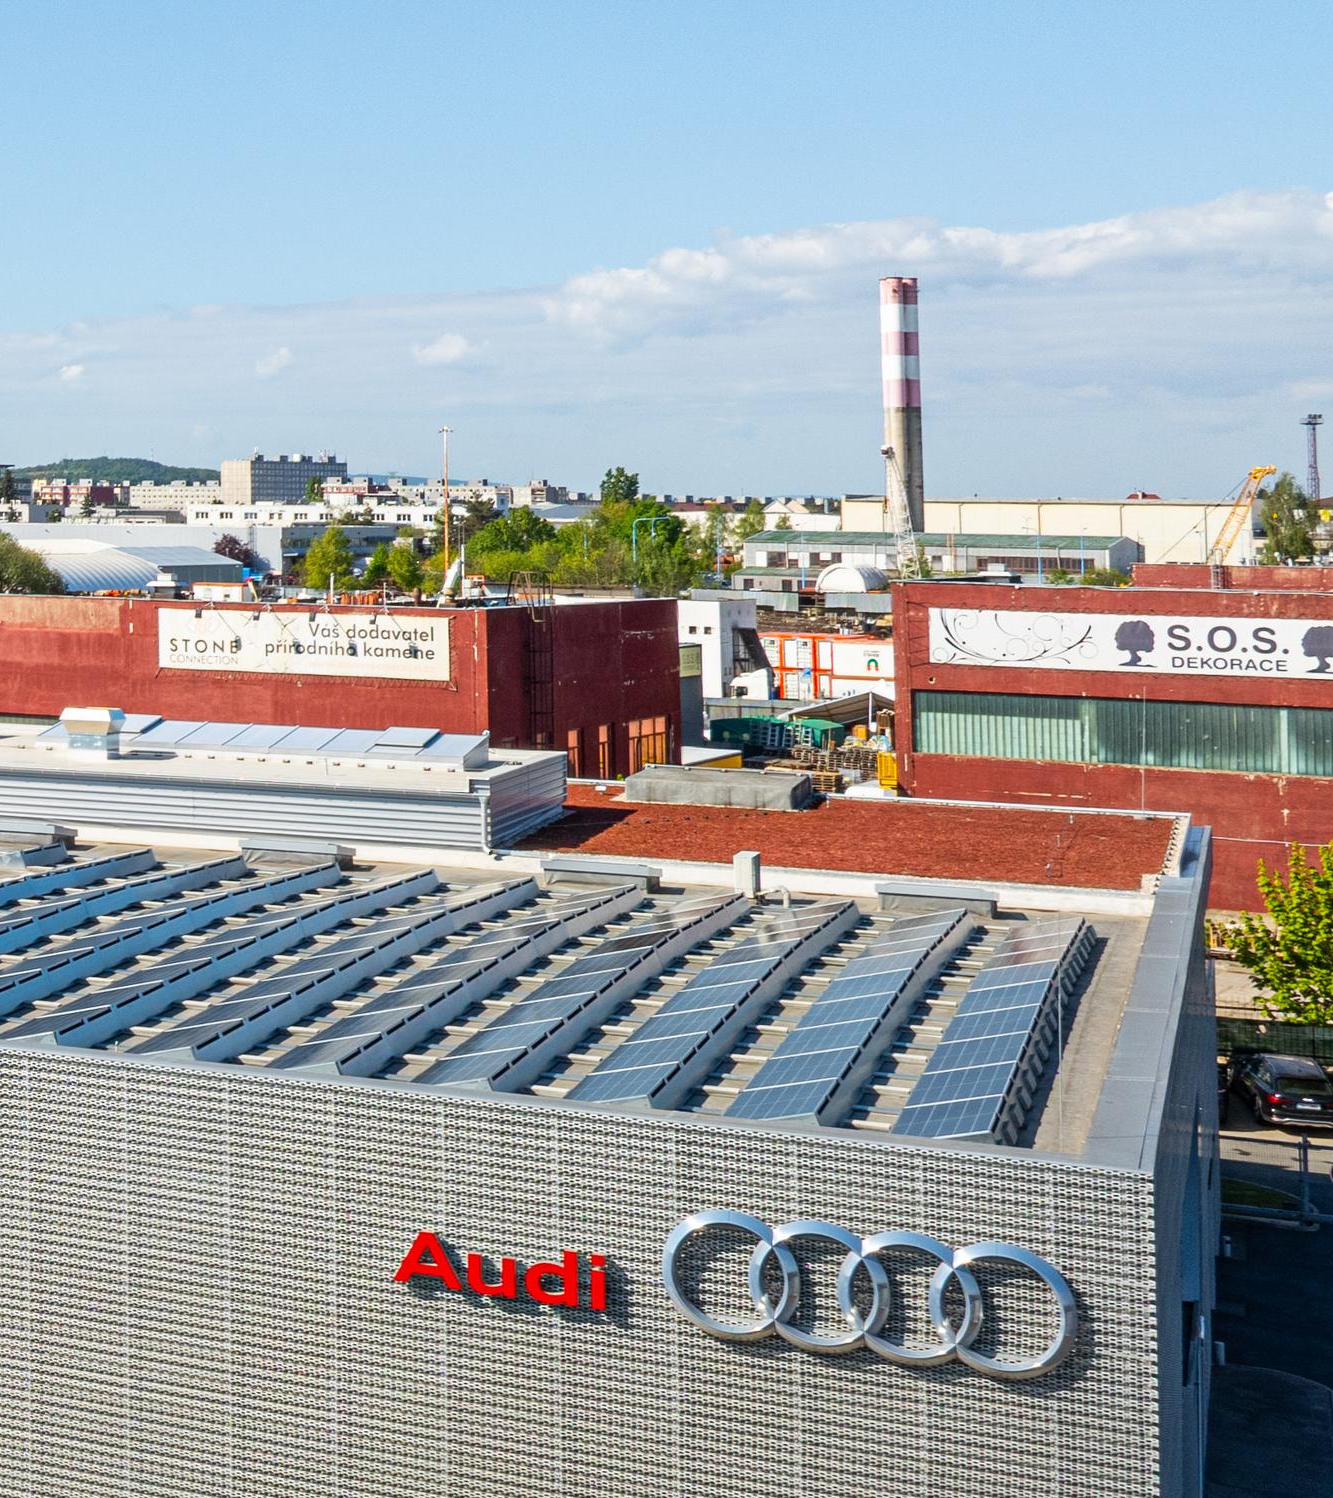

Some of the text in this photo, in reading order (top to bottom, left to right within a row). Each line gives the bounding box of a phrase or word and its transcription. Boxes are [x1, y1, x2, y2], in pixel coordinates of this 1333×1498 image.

[309, 623, 435, 642] Váš dodavatel
[1167, 624, 1290, 655] S.O.S.
[169, 638, 240, 653] STONE
[265, 640, 436, 660] přírodního kamene
[169, 654, 239, 665] CONNECTION
[1171, 656, 1288, 672] DEKORACE
[395, 1230, 607, 1311] Audi
